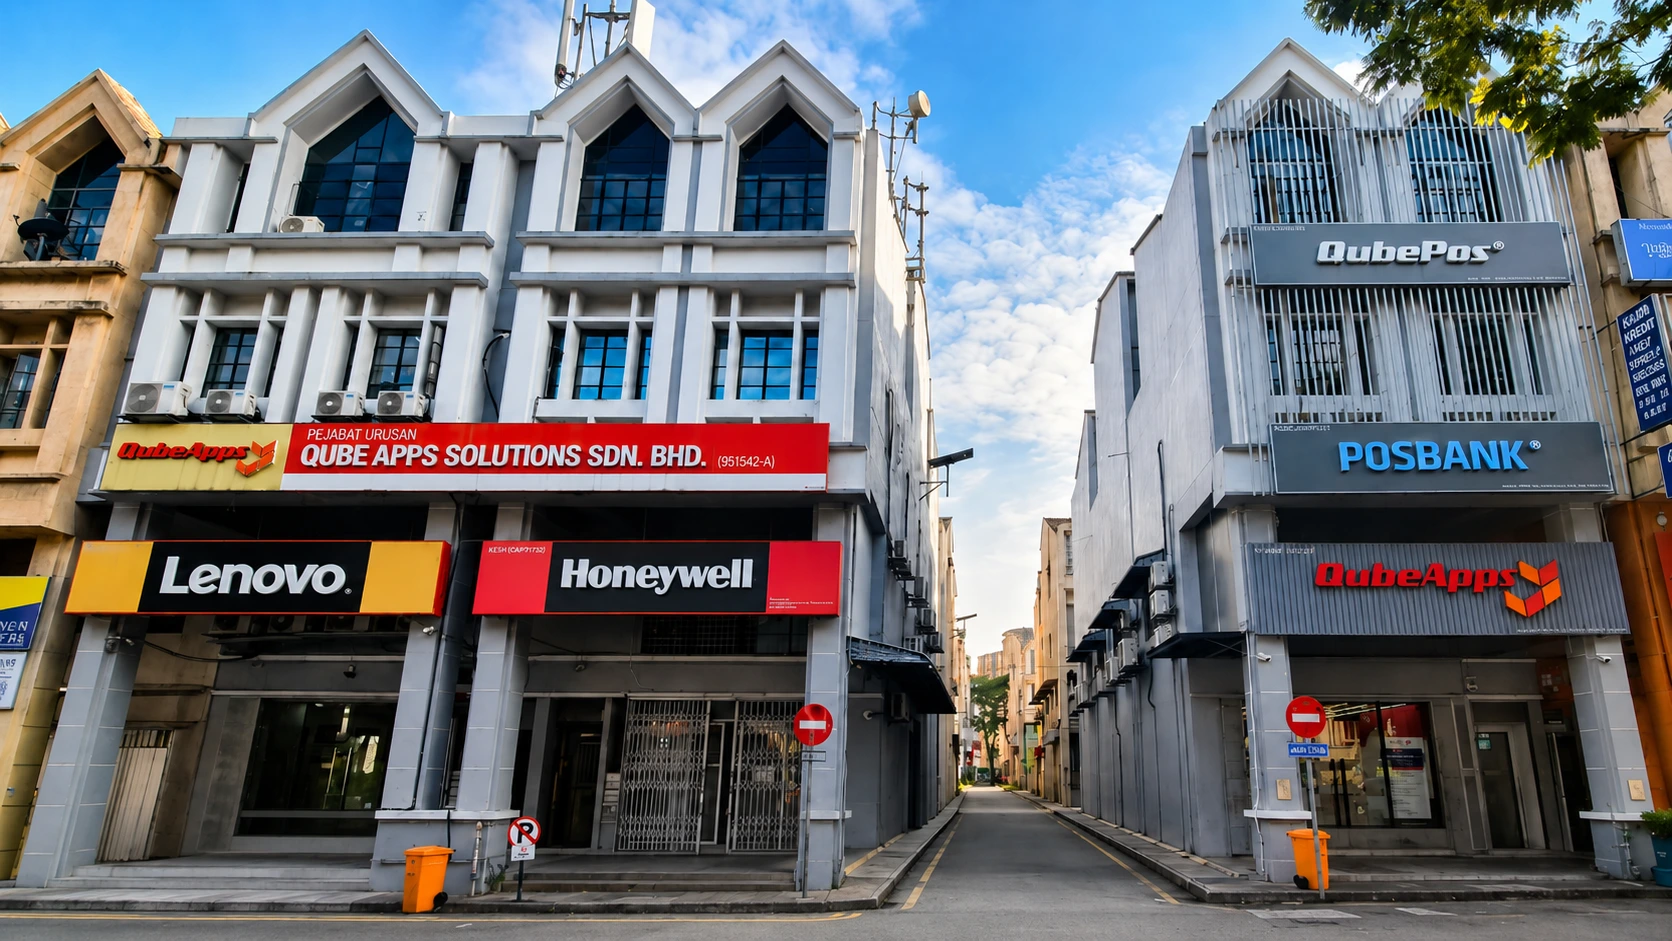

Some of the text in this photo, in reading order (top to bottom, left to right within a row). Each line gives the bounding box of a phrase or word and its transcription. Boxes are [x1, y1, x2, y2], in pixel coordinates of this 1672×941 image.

[1623, 316, 1655, 345] KREDIT
[307, 428, 417, 441] PEJABAT URUSAN
[117, 442, 250, 462] QubeApps
[300, 444, 775, 469] QUBE APPS SOLUTIONS SDN. BHD. (951542-A)
[560, 558, 754, 595] Honeywell
[1315, 562, 1518, 593] QubeApps
